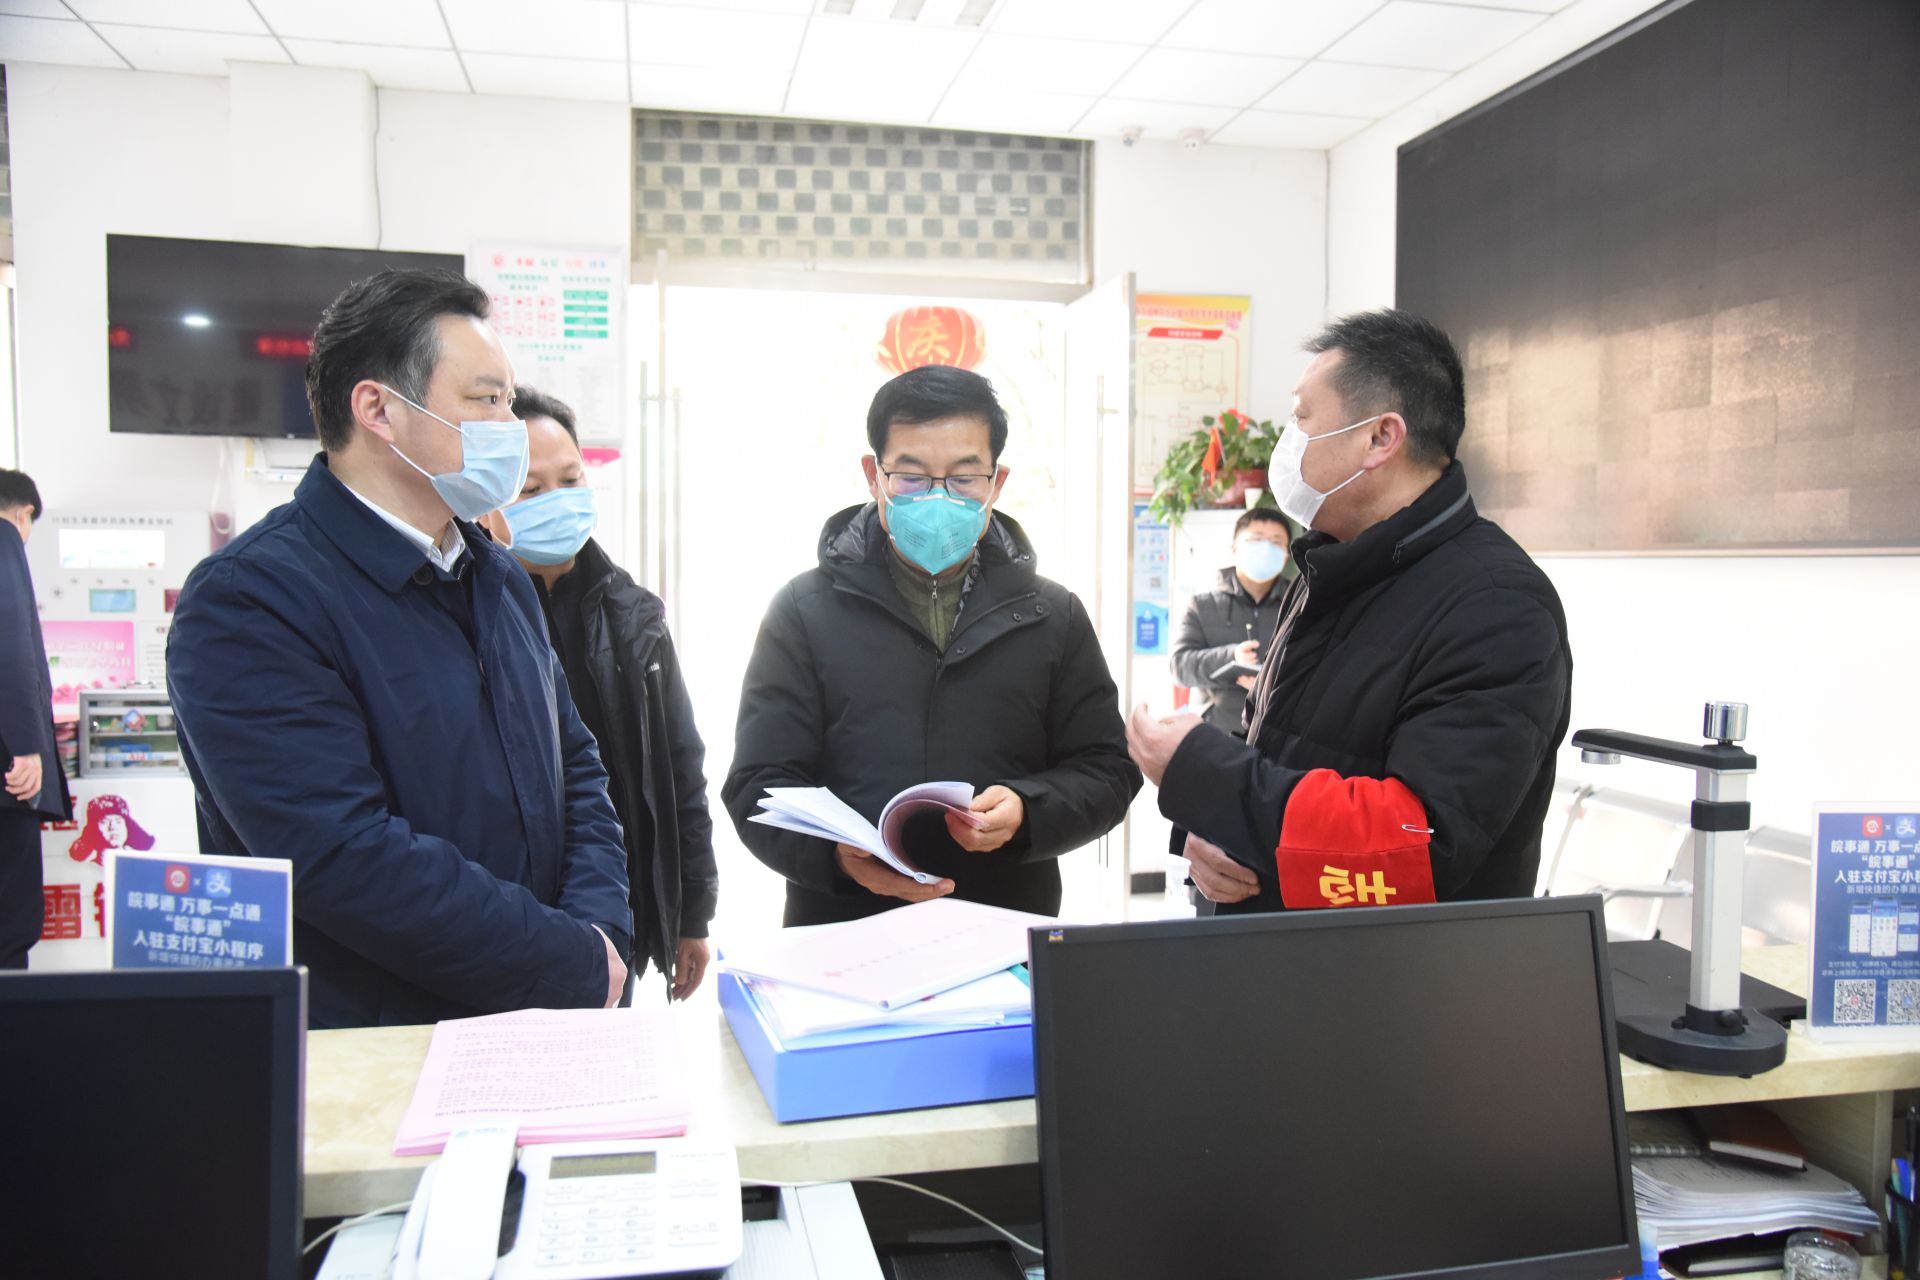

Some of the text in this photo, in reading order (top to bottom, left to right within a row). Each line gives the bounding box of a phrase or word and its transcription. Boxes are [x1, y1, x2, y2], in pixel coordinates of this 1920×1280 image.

[1831, 839, 1870, 854] 皖事通
[1847, 884, 1920, 895] 新增快捷的办事渠
[127, 891, 261, 921] 皖事通 万事一点通
